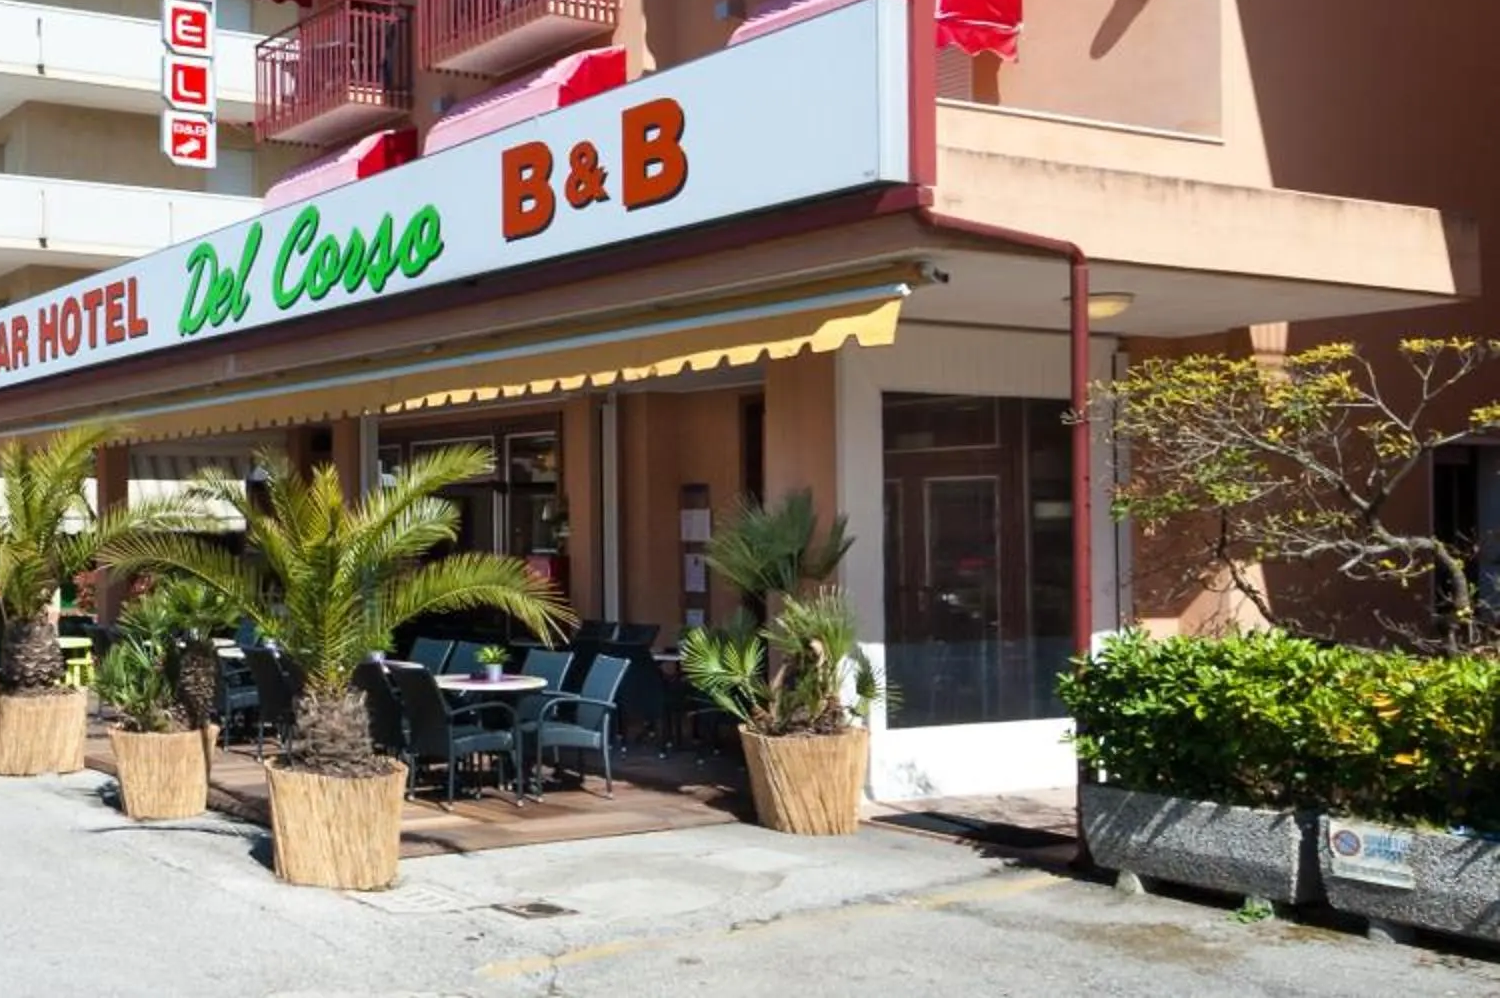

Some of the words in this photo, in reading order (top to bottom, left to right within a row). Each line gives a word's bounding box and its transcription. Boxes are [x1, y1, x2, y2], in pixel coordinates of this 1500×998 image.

[39, 278, 148, 362] HOTEL
[177, 219, 263, 336] Del
[270, 203, 443, 311] Corso
